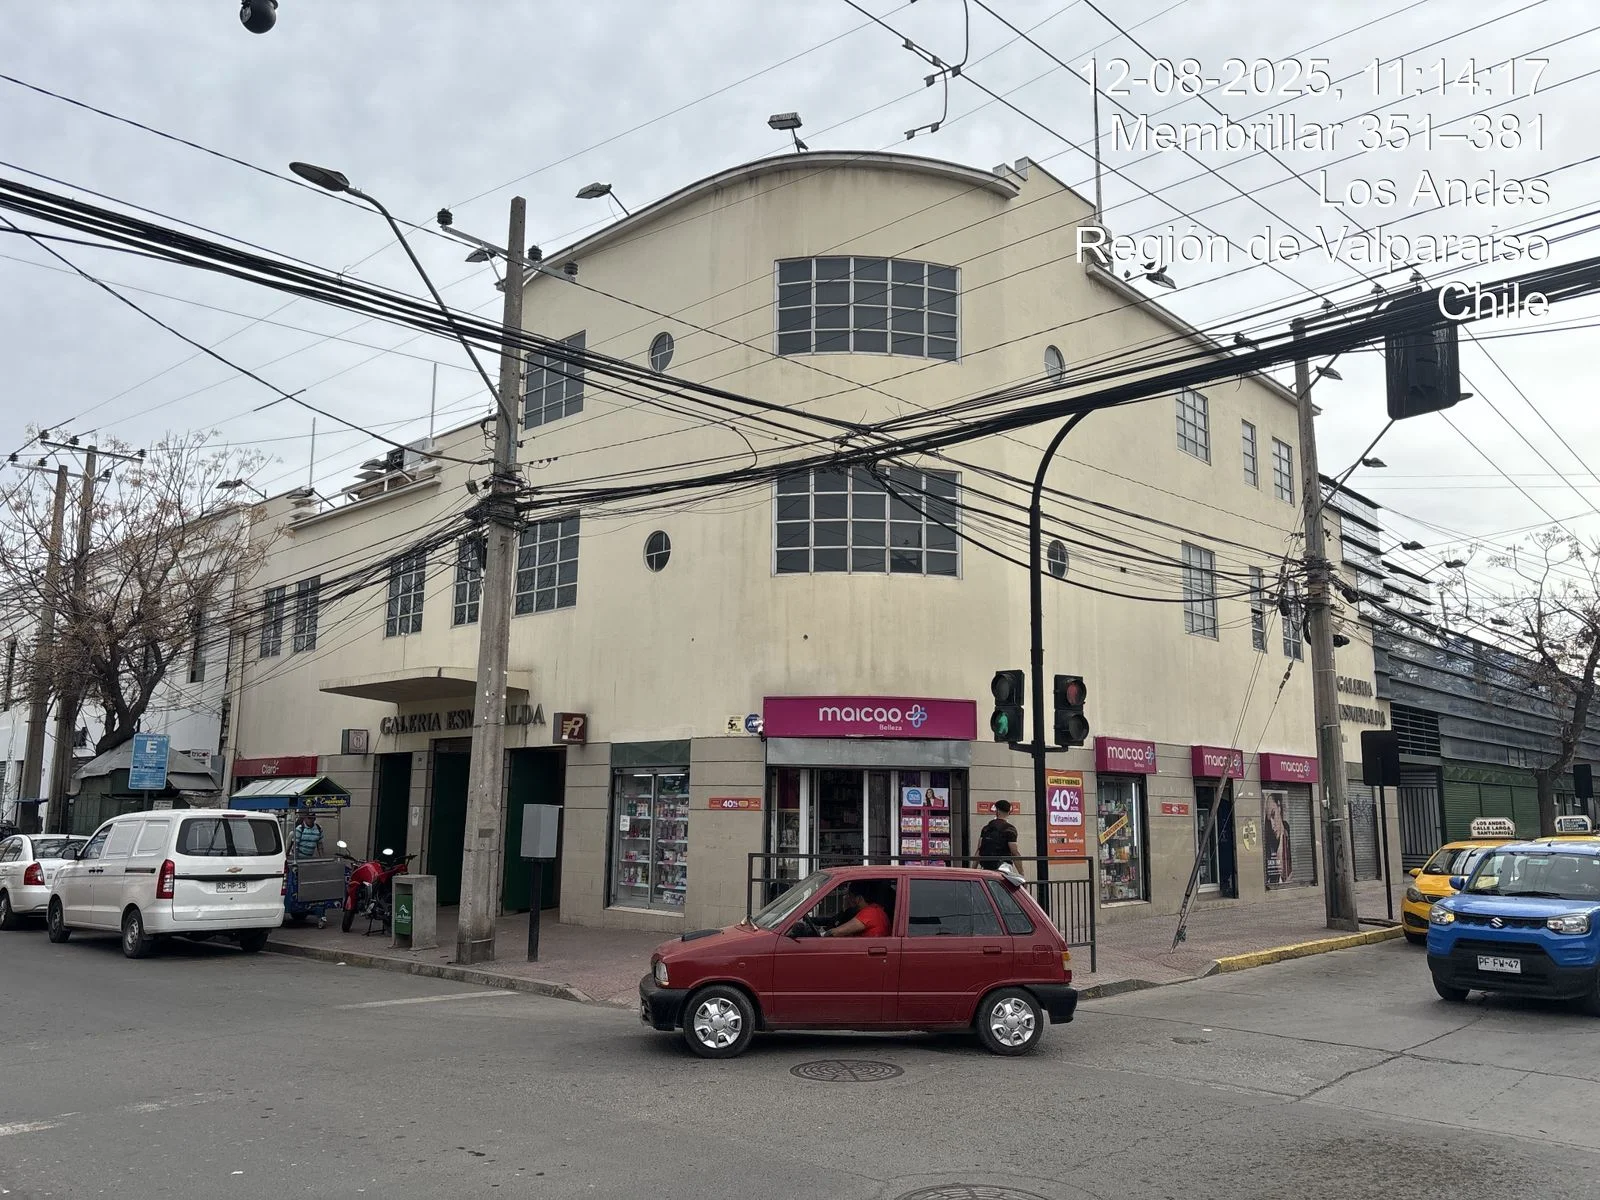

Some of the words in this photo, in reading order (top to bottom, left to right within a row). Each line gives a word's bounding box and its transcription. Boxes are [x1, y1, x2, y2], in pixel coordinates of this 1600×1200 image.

[380, 713, 442, 735] GALERIA
[446, 703, 547, 731] ESMALDA
[819, 706, 901, 723] maicao
[879, 723, 902, 731] Belleza
[146, 740, 158, 754] E
[1107, 746, 1144, 761] maicao
[261, 761, 278, 774] Claro
[1280, 760, 1304, 773] maicao
[1051, 789, 1079, 811] 40%
[1053, 814, 1079, 823] Vitaminas
